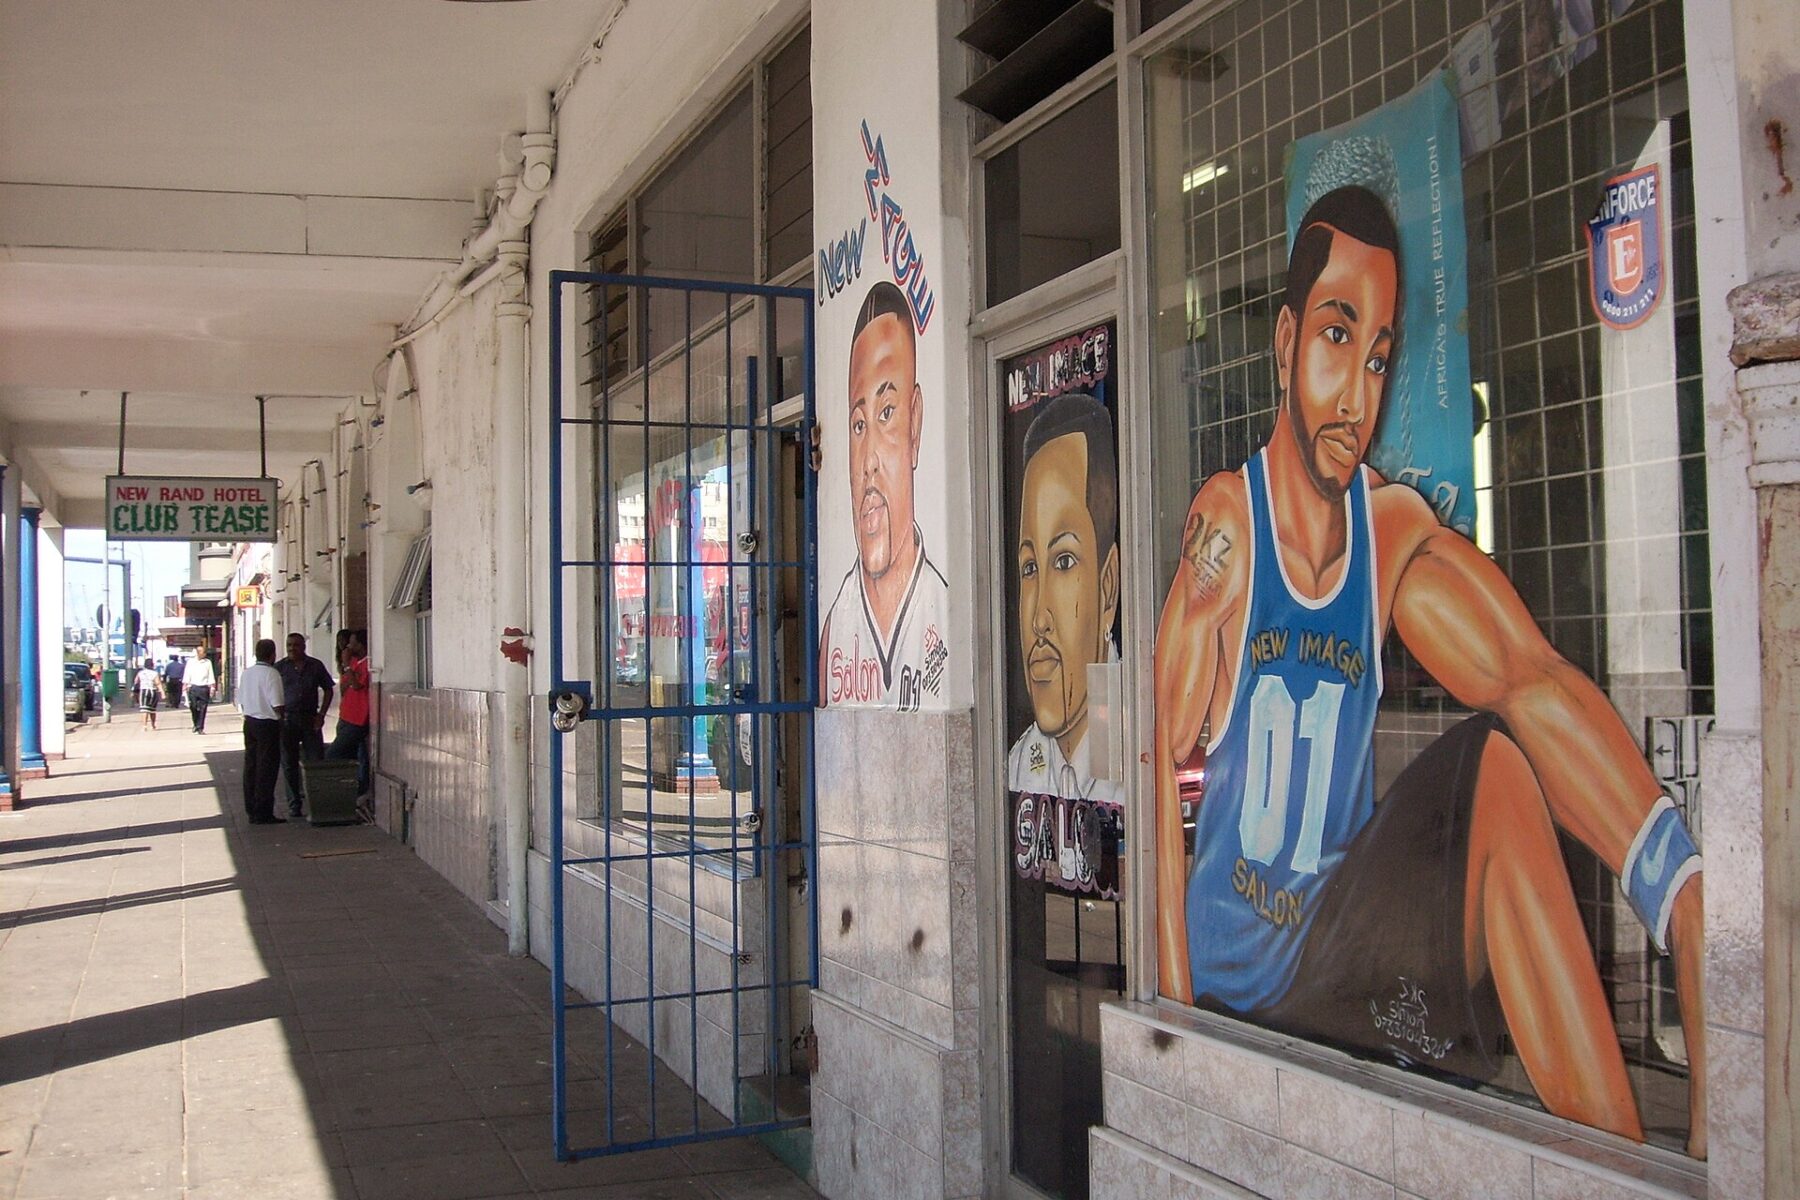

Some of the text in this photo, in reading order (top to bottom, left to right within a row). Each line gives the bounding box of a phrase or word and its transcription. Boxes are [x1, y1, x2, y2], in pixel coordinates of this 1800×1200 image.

[1589, 175, 1656, 224] NFORCE
[860, 118, 936, 337] IMAGE
[1612, 234, 1639, 281] E
[1433, 266, 1446, 317] TRUE
[1622, 303, 1638, 317] 211
[1639, 288, 1654, 309] 211
[1435, 323, 1449, 408] AFRICA'S
[112, 503, 269, 534] CLUB TEASE
[116, 487, 267, 502] NEW RAND HOTEL
[831, 633, 882, 703] Salon
[1250, 628, 1366, 688] NEW IMAGE
[897, 664, 922, 712] 01
[1239, 674, 1346, 874] 01
[1231, 858, 1305, 931] SALON
